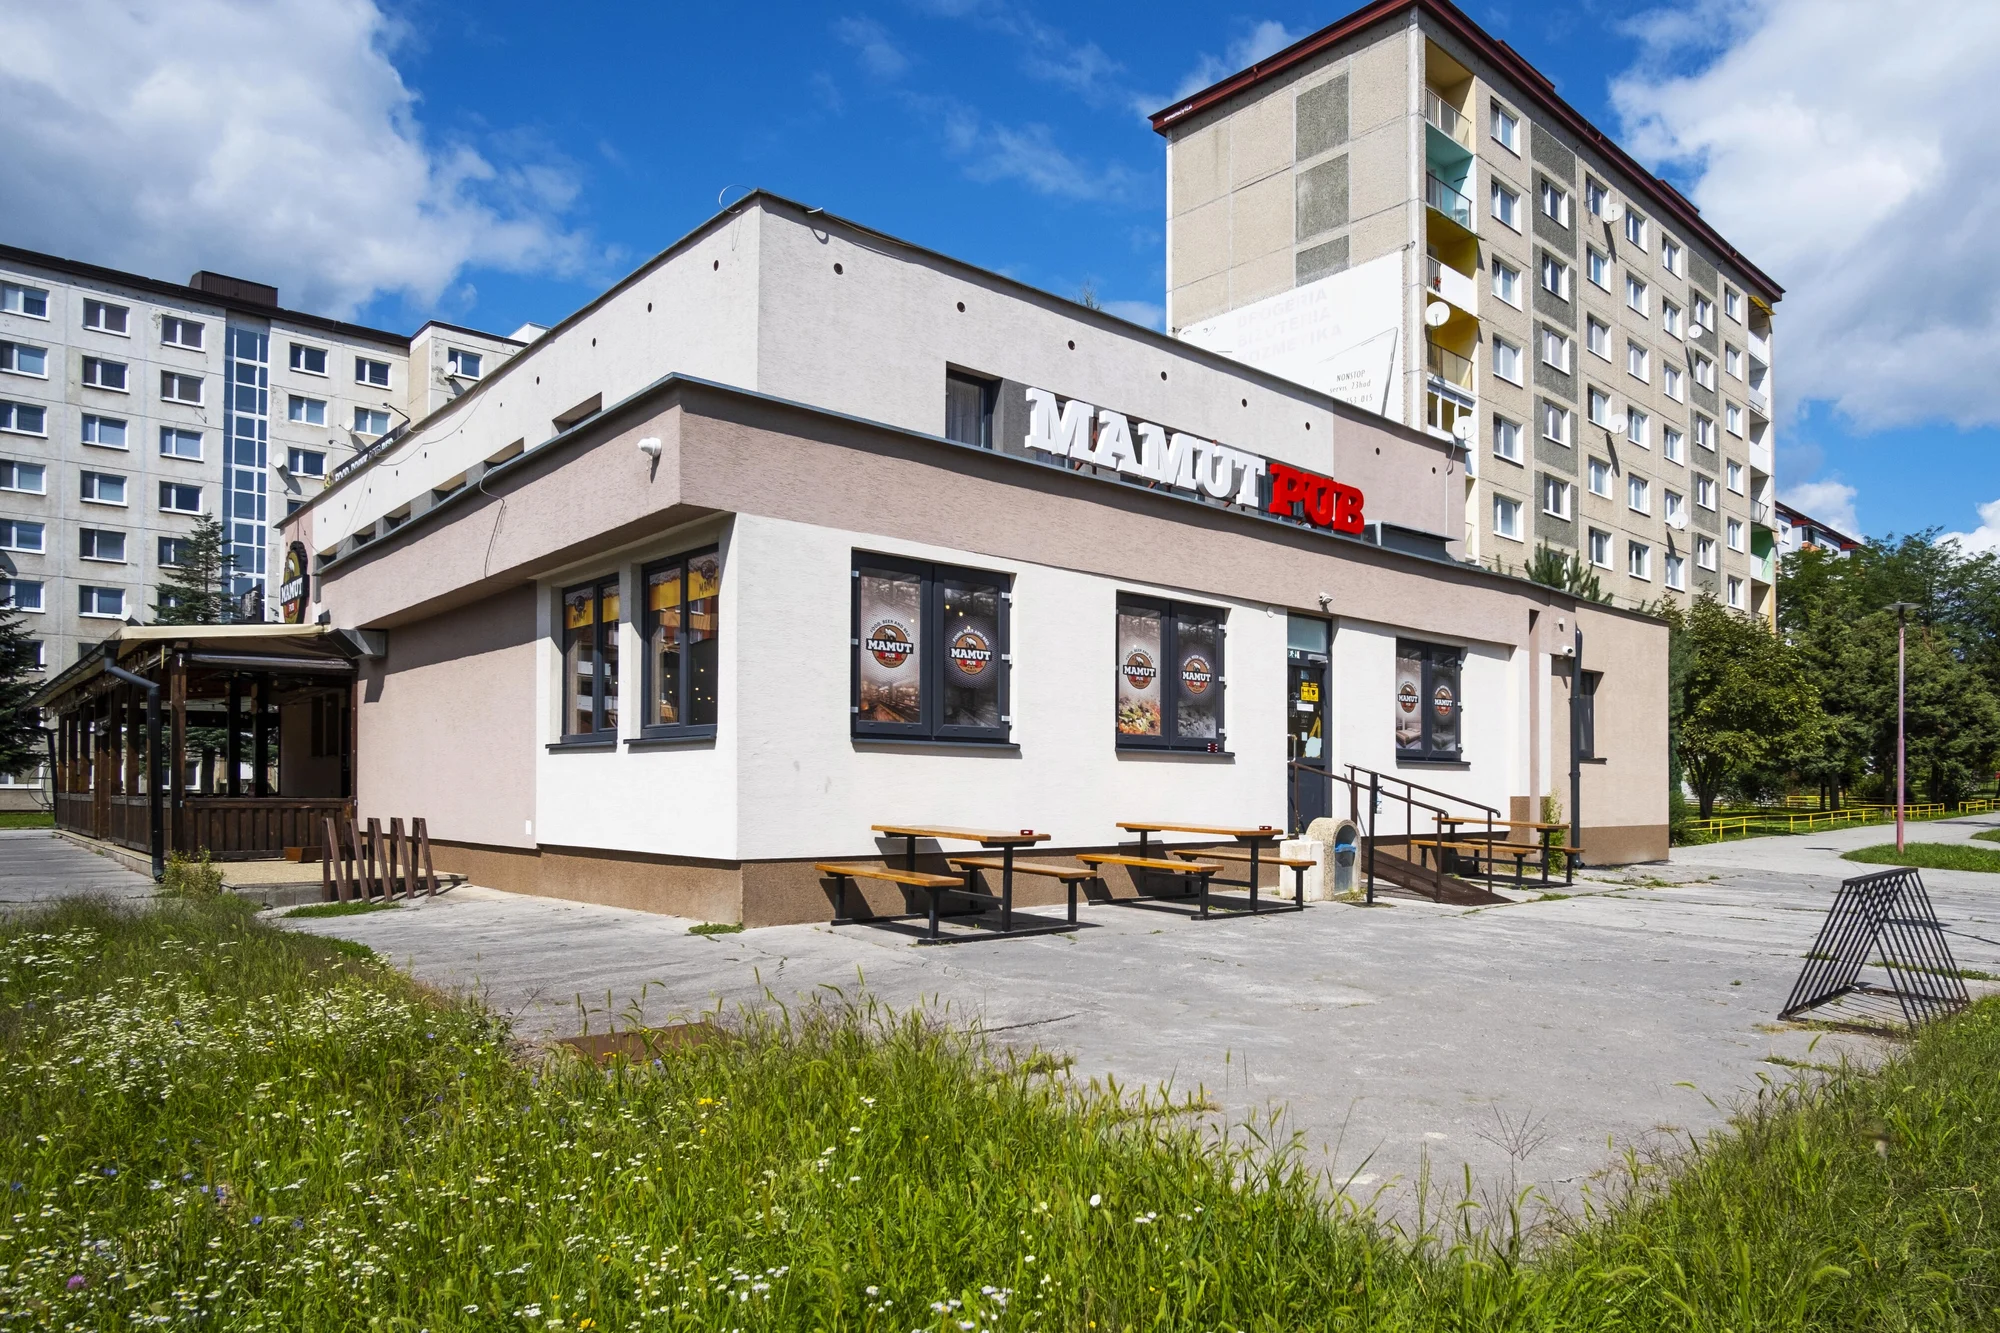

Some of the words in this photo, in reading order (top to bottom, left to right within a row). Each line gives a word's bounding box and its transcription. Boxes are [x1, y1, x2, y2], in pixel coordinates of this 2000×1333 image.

[1336, 369, 1366, 382] NONSTOP
[1025, 387, 1266, 508] MAMUT
[1268, 463, 1365, 535] PUB
[281, 577, 303, 604] MAMUT
[894, 620, 904, 629] AND
[867, 639, 912, 653] MAMUT
[950, 648, 991, 661] MAMUT
[1123, 666, 1155, 677] MAMUT
[1182, 671, 1211, 682] MAMUT
[1398, 694, 1418, 703] MAMUT
